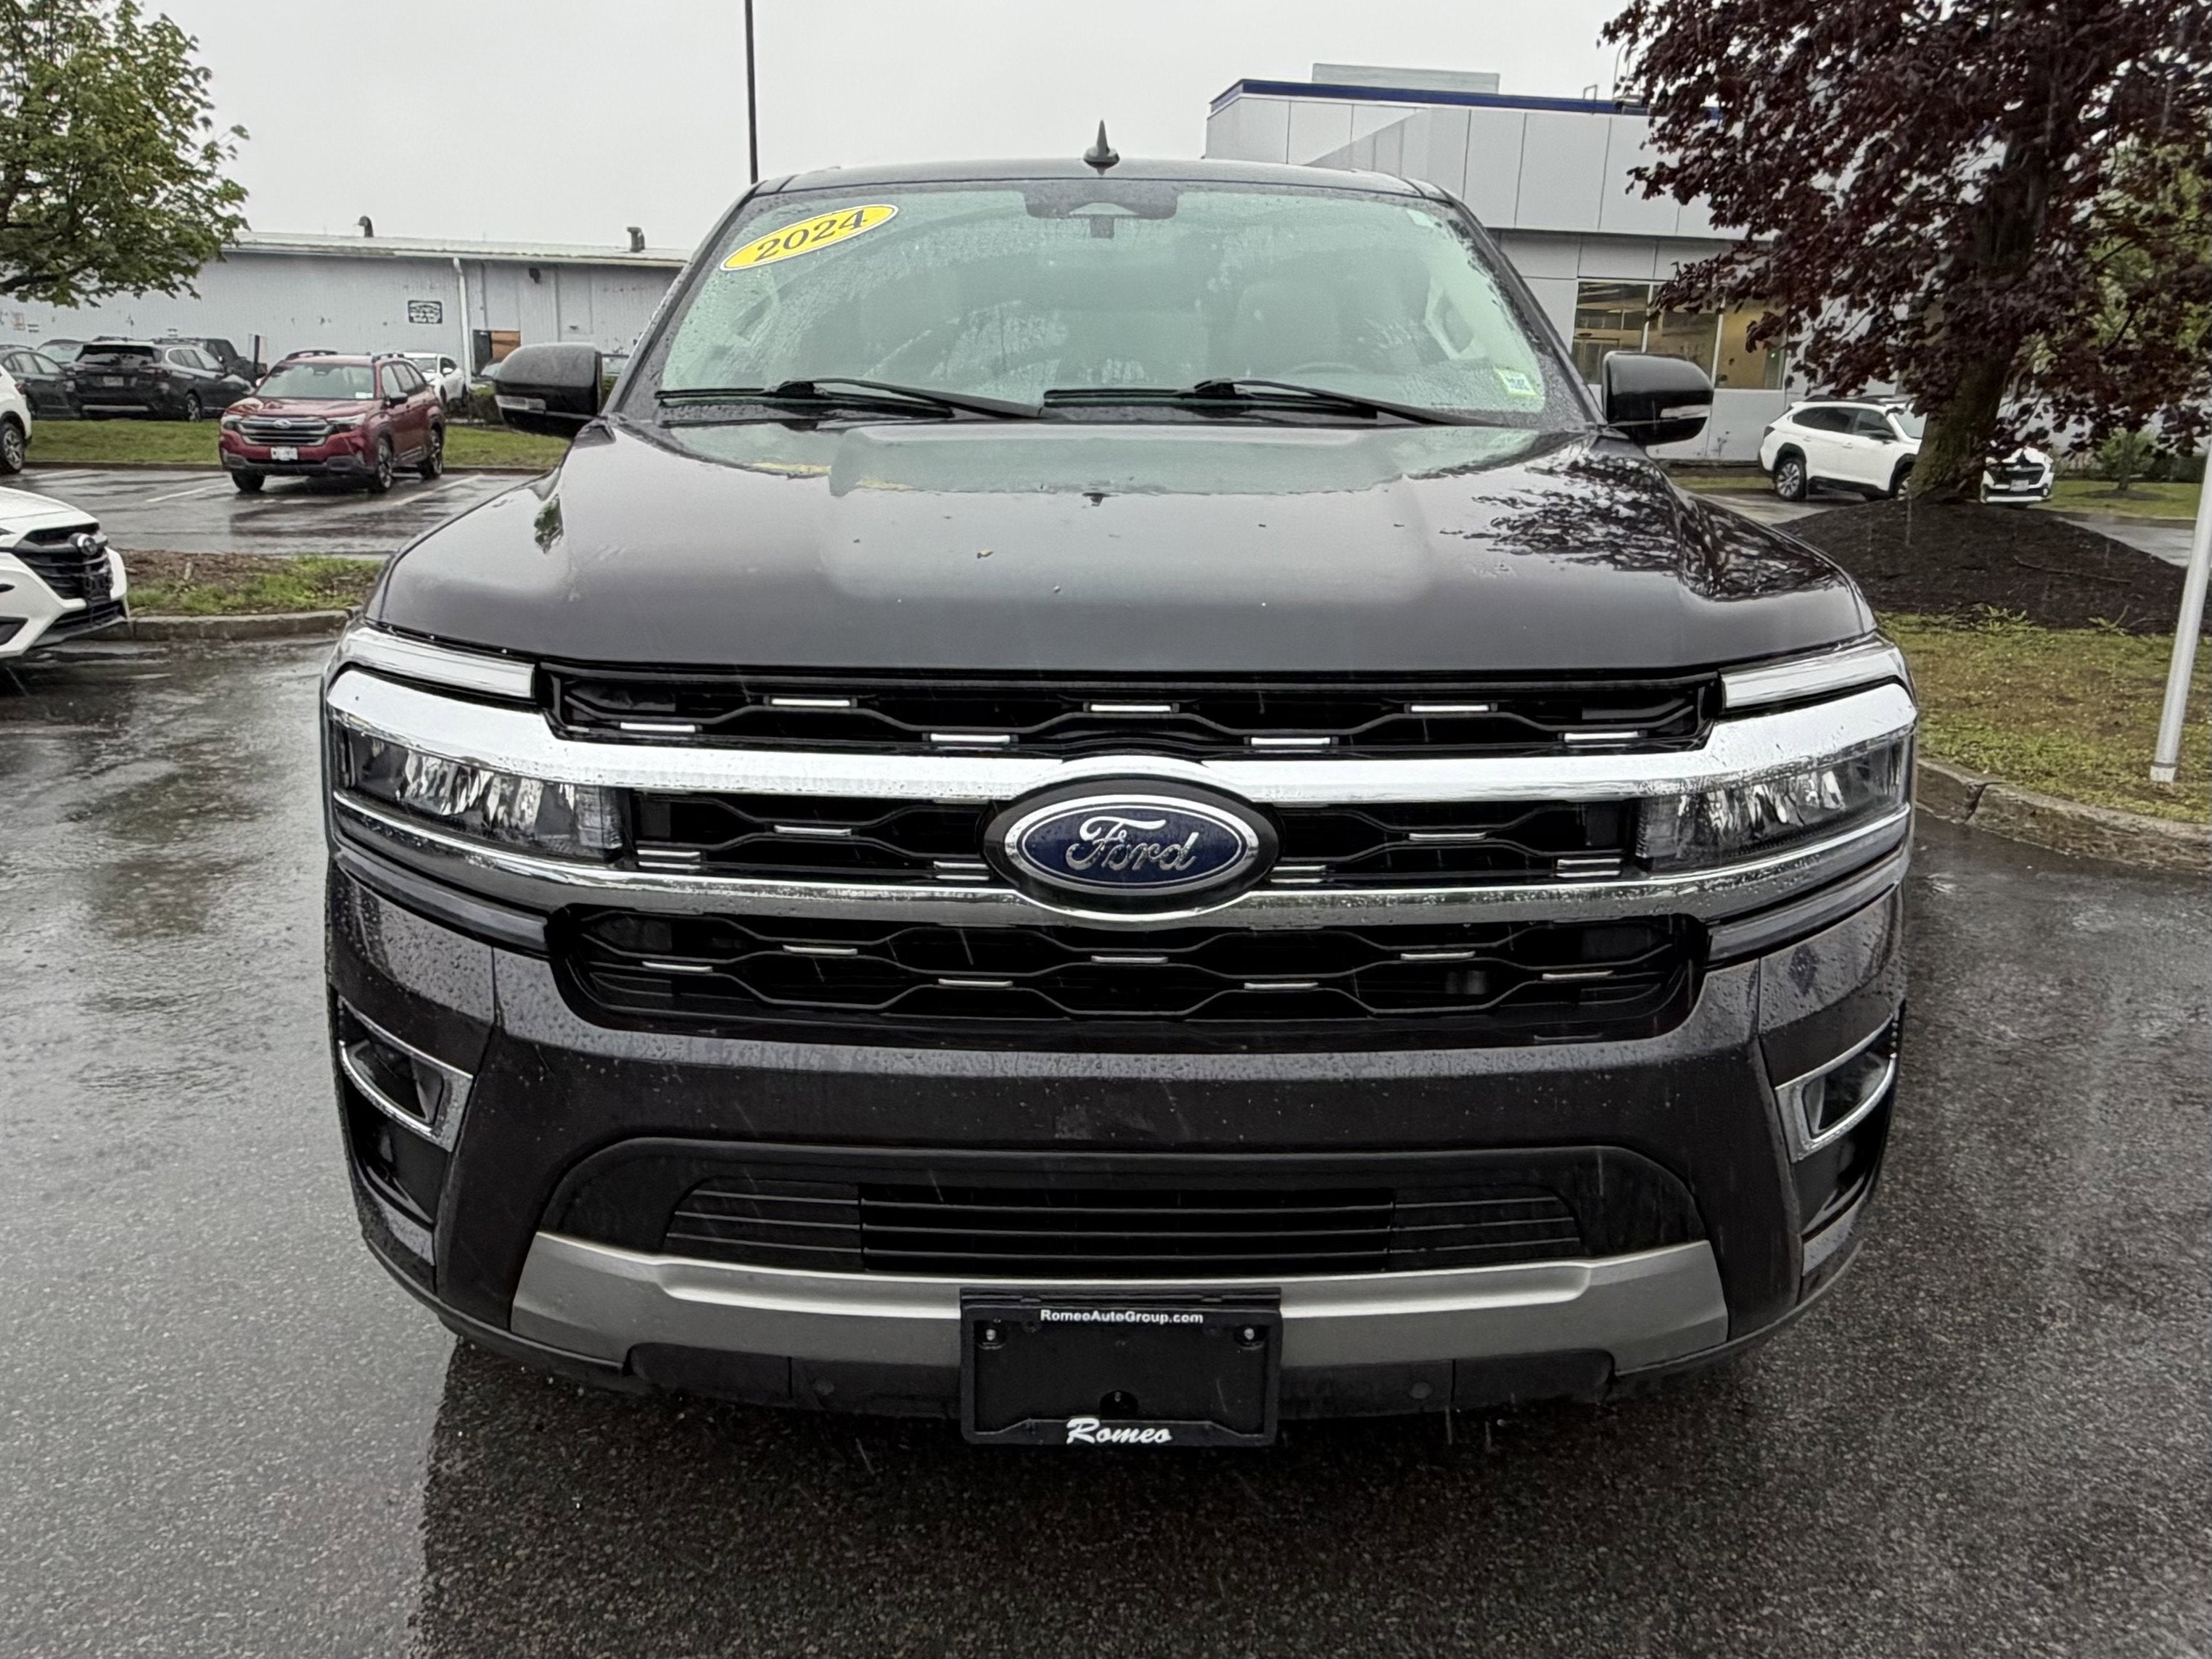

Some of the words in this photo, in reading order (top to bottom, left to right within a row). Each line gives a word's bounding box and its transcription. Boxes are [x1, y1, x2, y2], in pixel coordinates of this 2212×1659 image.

[755, 210, 868, 262] 2024
[1066, 816, 1200, 870] Ford
[1040, 1309, 1204, 1324] RomeoAutoGroup.com
[1066, 1417, 1172, 1444] Romeo
